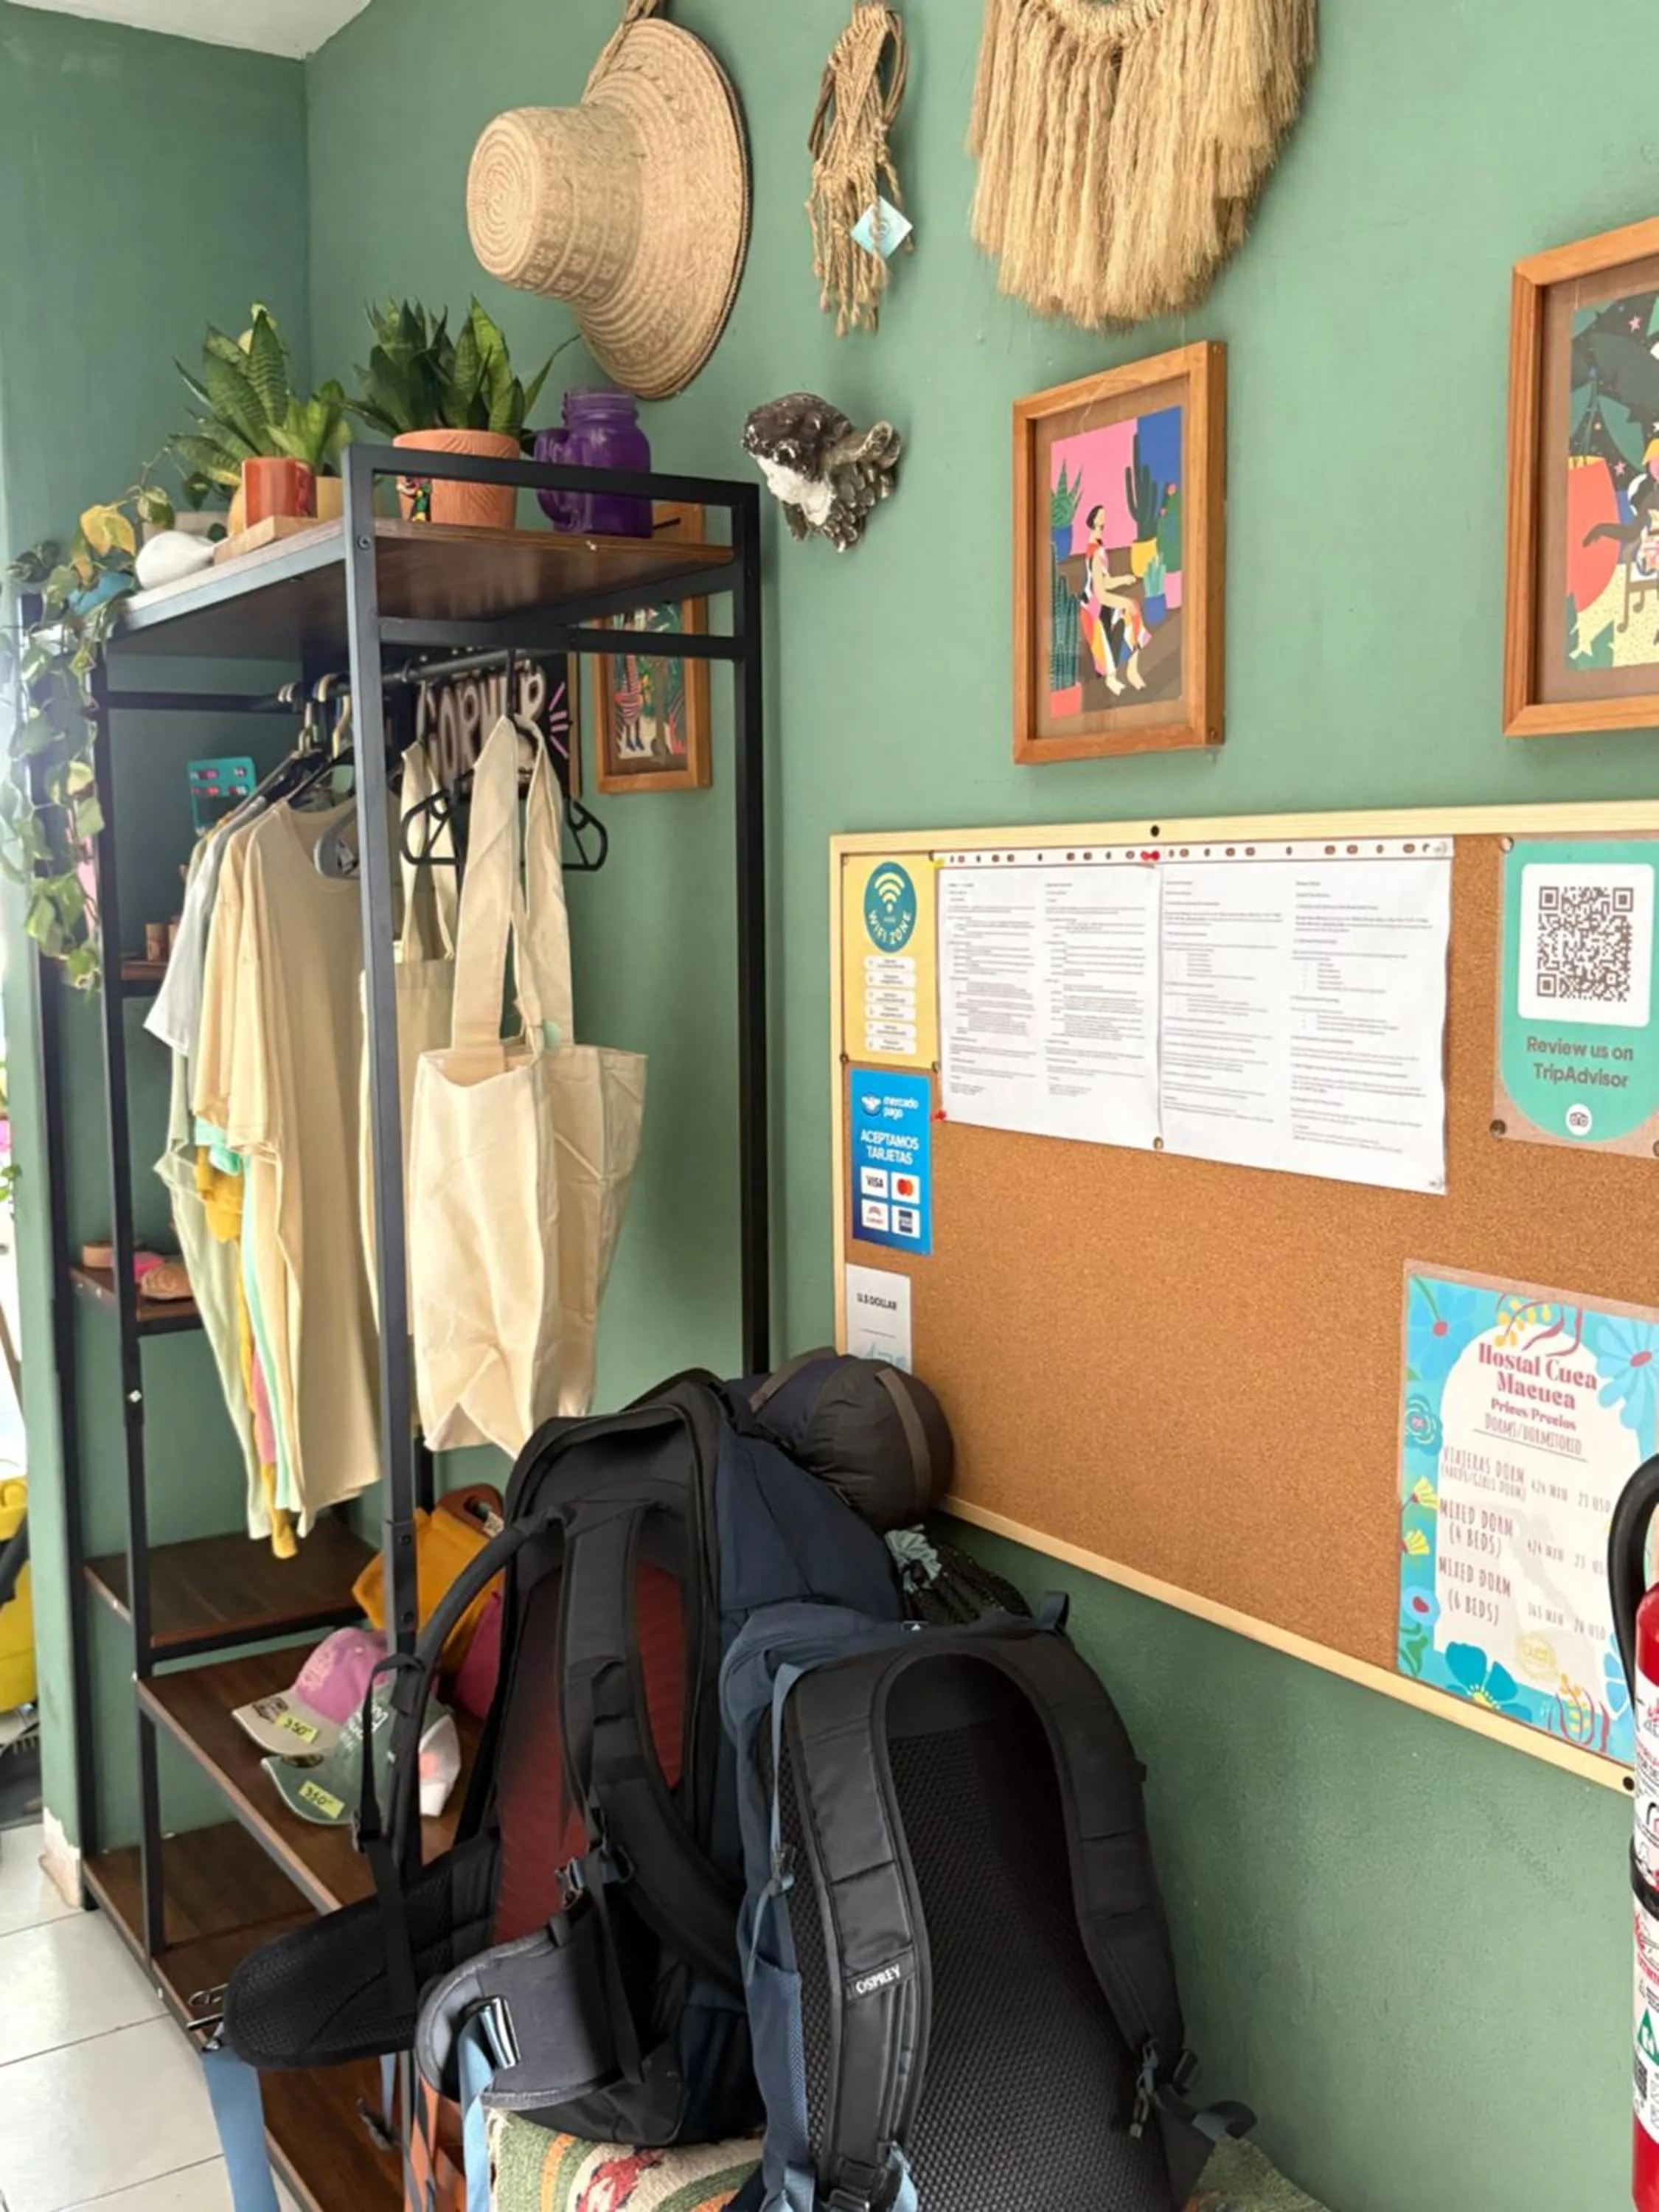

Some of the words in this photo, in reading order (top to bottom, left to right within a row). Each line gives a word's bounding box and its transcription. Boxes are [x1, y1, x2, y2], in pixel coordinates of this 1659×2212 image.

[1527, 1036, 1587, 1057] Review
[1590, 1044, 1609, 1060] us
[1611, 1047, 1634, 1062] on
[1533, 1062, 1629, 1088] TripAdvisor
[883, 1107, 904, 1121] pago
[860, 1128, 919, 1150] ACEPTAMOS
[866, 1144, 914, 1166] TARJETAS
[866, 1175, 884, 1189] VISA
[1478, 1343, 1541, 1377] Hostal
[1439, 1498, 1475, 1525] MIXED
[1481, 1509, 1514, 1537] DORM
[1467, 1528, 1503, 1559] BEDS)
[1439, 1555, 1475, 1584] MIXED
[1478, 1568, 1512, 1598] DORM
[1465, 1596, 1500, 1627] BEDS)
[855, 1964, 900, 1994] OSPREY
